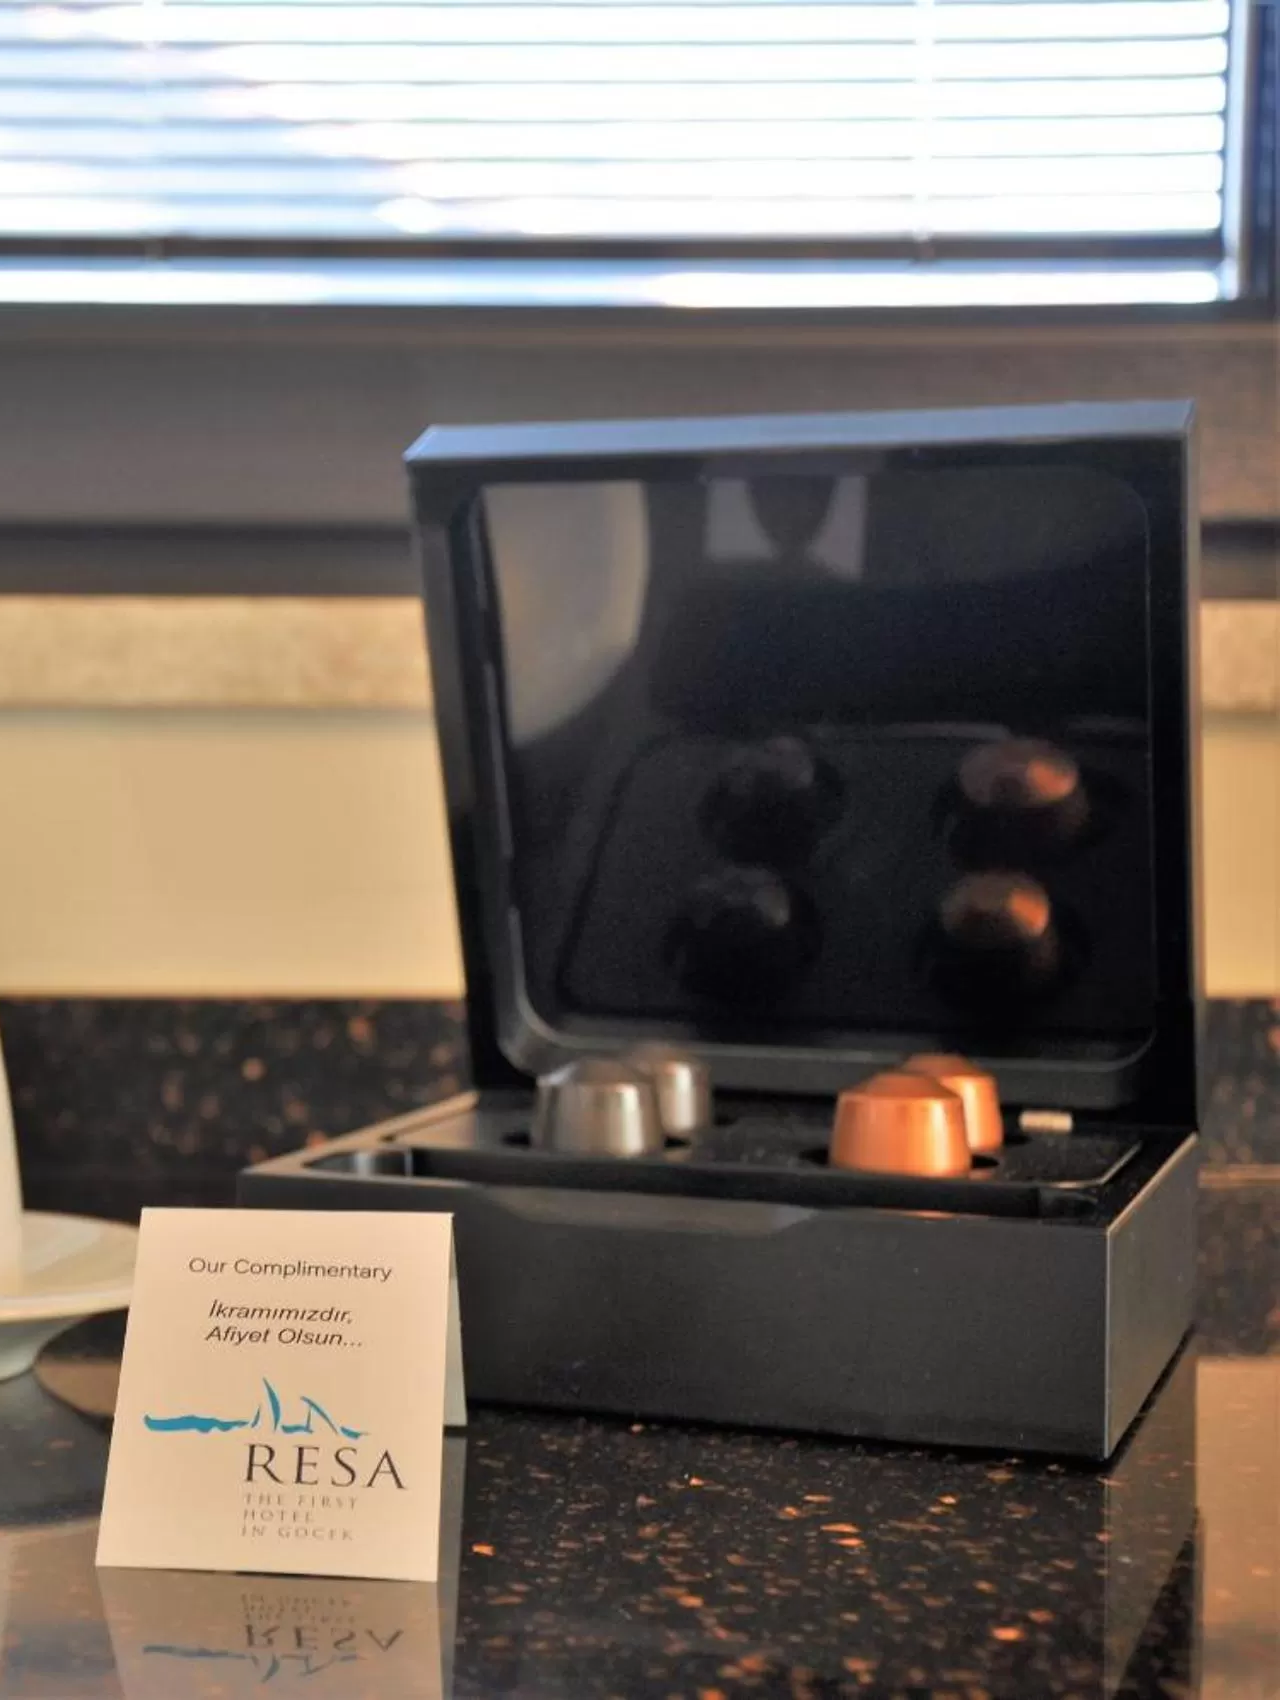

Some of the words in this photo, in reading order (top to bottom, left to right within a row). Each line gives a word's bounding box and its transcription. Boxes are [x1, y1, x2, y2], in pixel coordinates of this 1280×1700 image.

[189, 1257, 227, 1273] Our
[234, 1259, 392, 1282] Complimentary
[205, 1326, 270, 1345] Afiyet
[278, 1328, 363, 1347] Olsun...
[245, 1443, 407, 1490] RESA
[245, 1493, 284, 1505] THE
[298, 1495, 358, 1511] FIRST
[243, 1509, 315, 1522] HOTEL
[241, 1525, 266, 1537] IN
